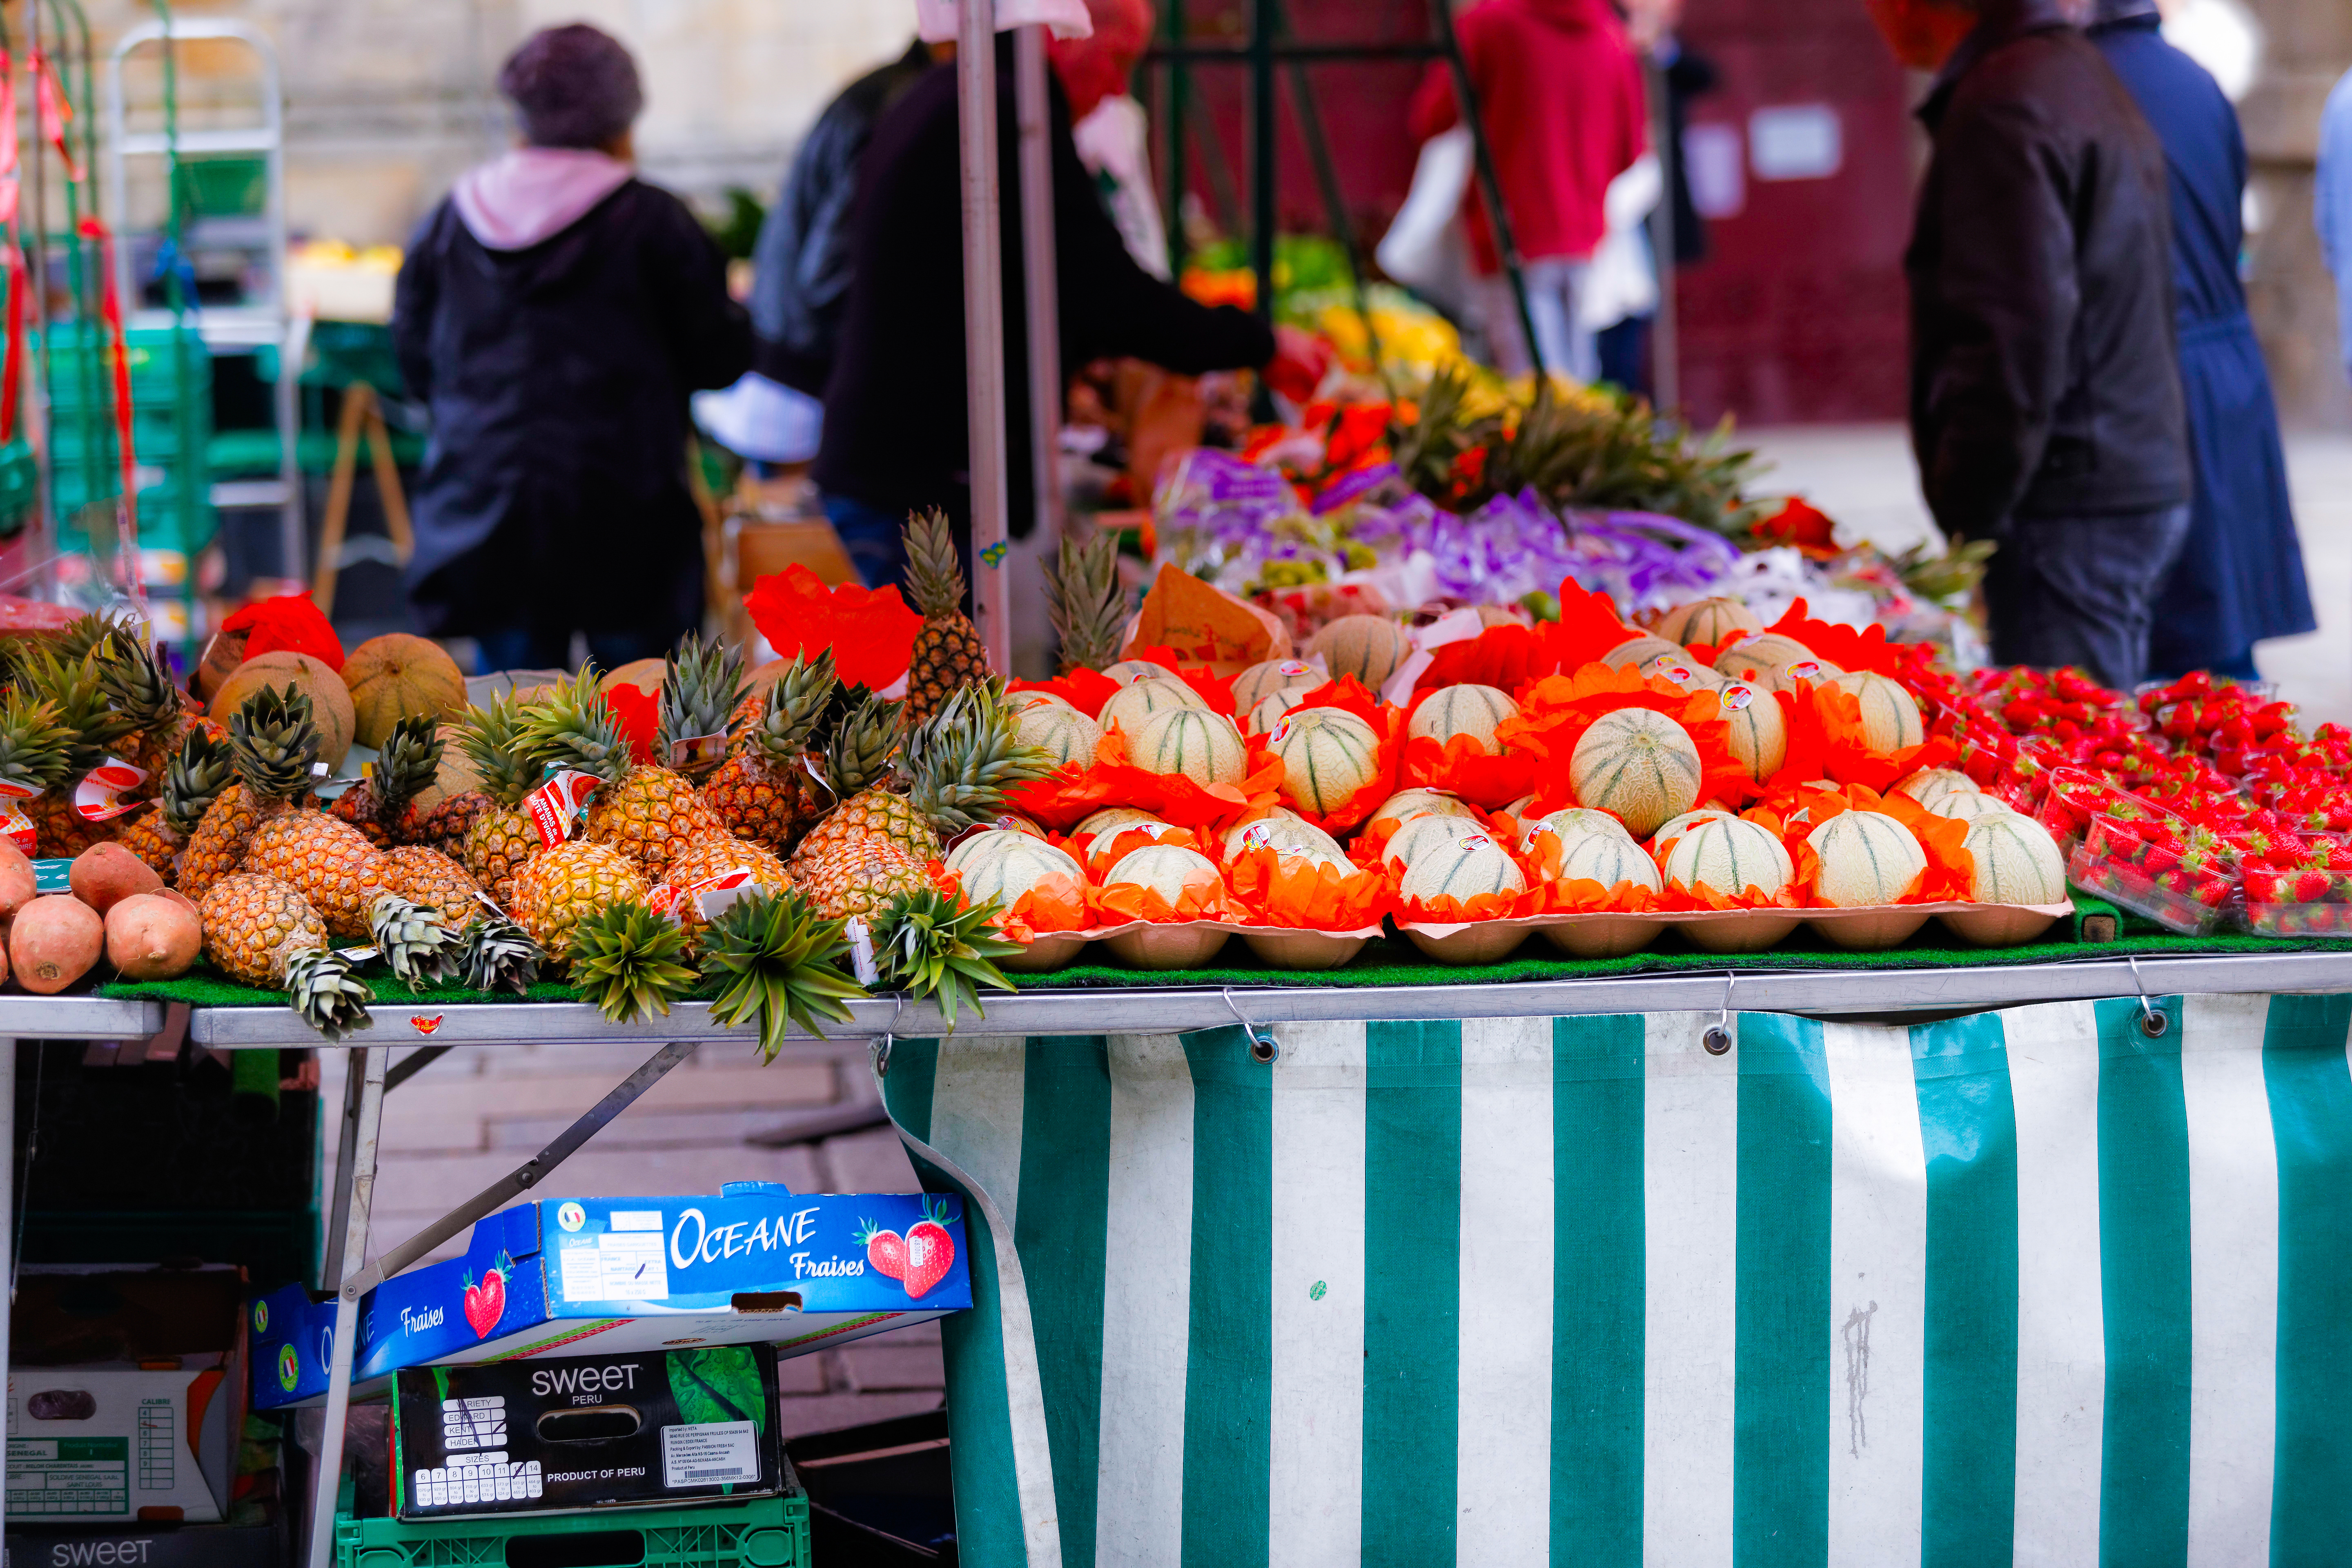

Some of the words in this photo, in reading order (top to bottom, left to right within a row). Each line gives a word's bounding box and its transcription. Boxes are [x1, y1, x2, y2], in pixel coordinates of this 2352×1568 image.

[529, 795, 543, 815] CÔTE
[539, 813, 556, 845] D'IVOIRE
[539, 798, 555, 827] ANANAS
[671, 1207, 821, 1270] OCEANE
[788, 1250, 865, 1280] Fraises
[401, 1305, 444, 1338] Fraises
[572, 1394, 603, 1405] PERU
[548, 1471, 598, 1482] PRODUCT
[600, 1469, 615, 1479] OF
[617, 1467, 646, 1478] PERU
